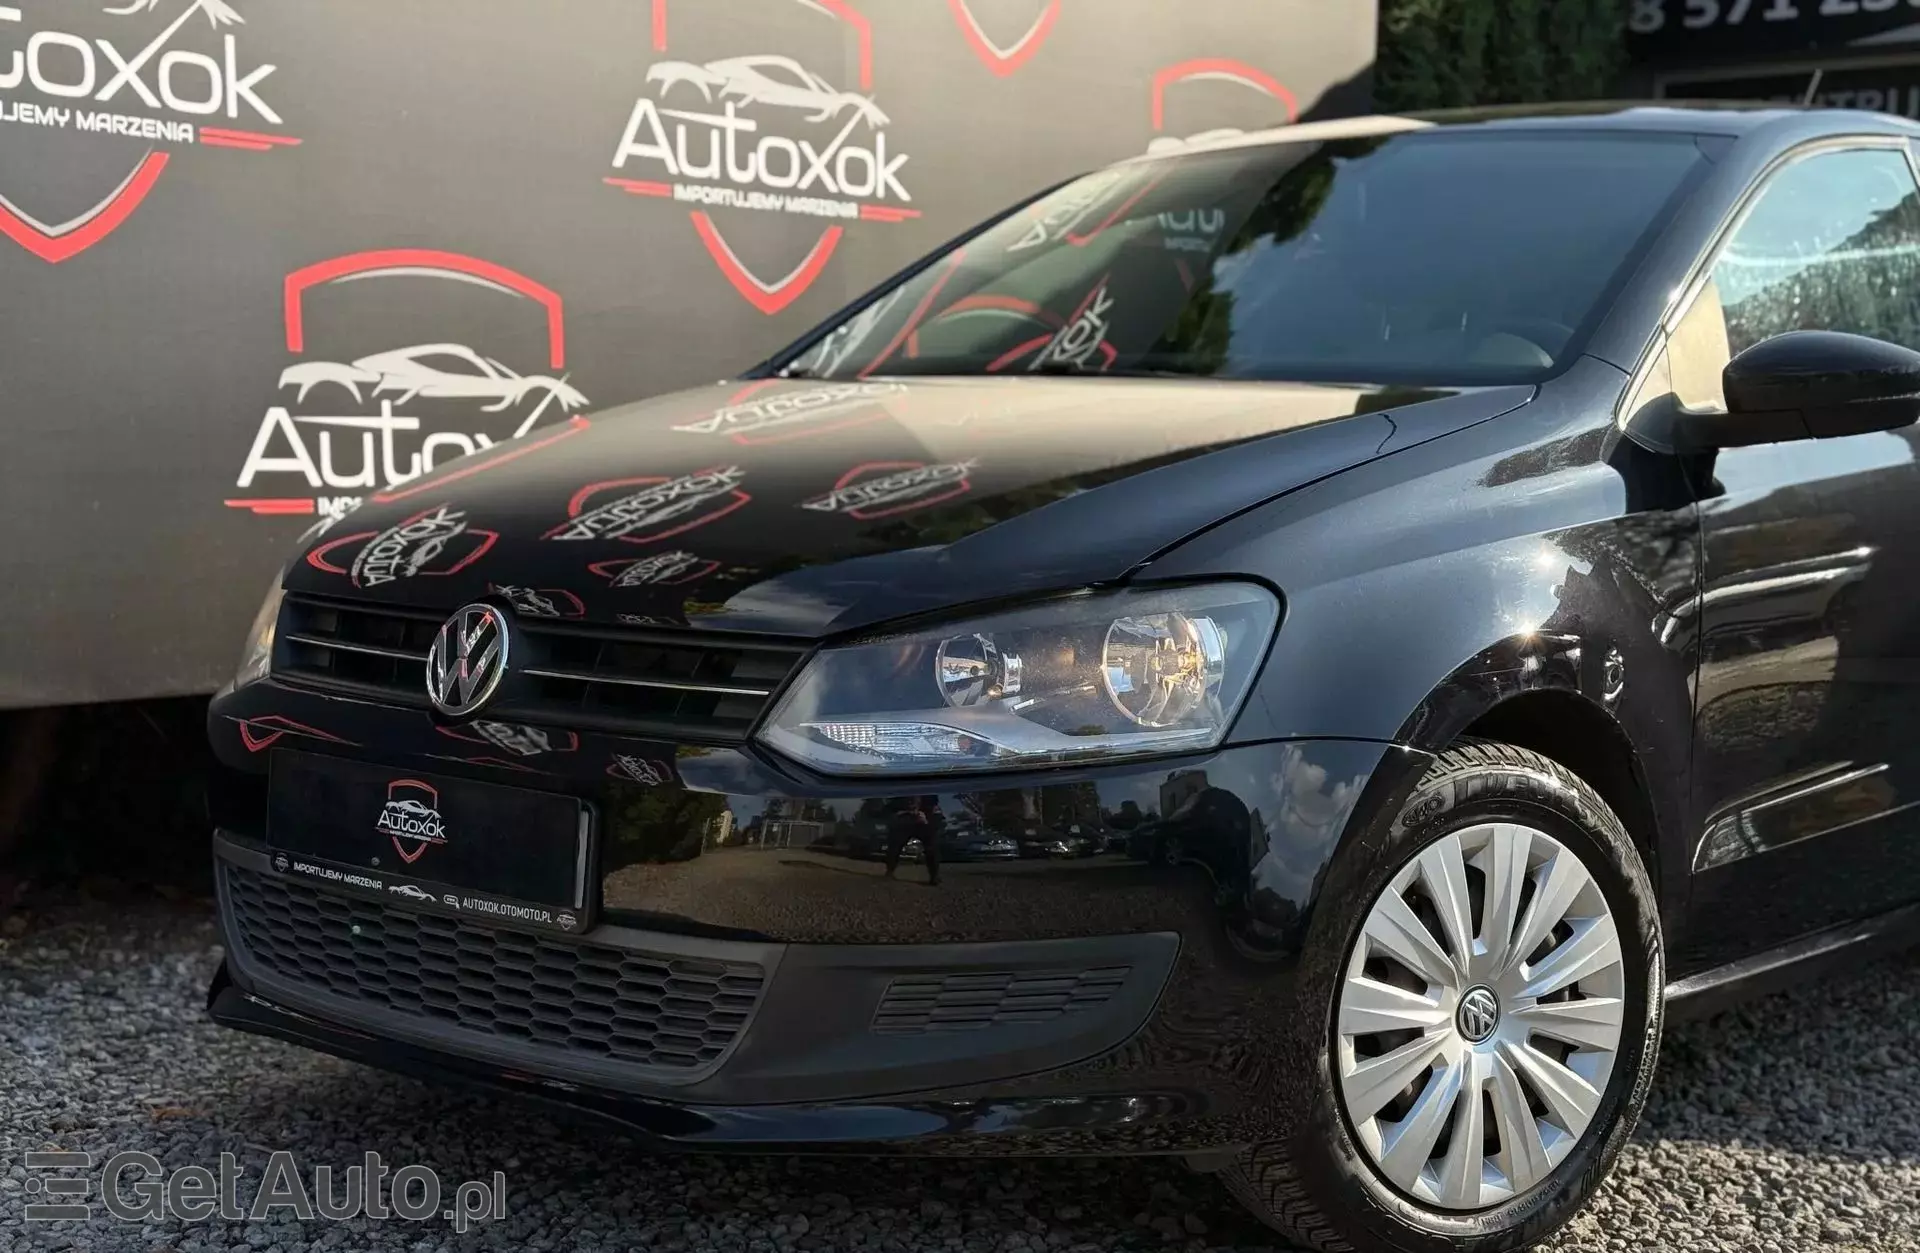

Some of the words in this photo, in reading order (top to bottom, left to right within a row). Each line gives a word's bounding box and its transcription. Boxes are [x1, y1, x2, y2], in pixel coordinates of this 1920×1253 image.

[0, 102, 70, 127] JEMY
[76, 109, 194, 143] MARZENIA
[612, 98, 912, 202] Autoxok
[377, 809, 446, 839] Autoxok
[293, 861, 343, 881] IMPORTUJEMY
[343, 874, 383, 890] MARZENIA
[462, 897, 553, 924] AUTOXOK.OTOMOTO.PL
